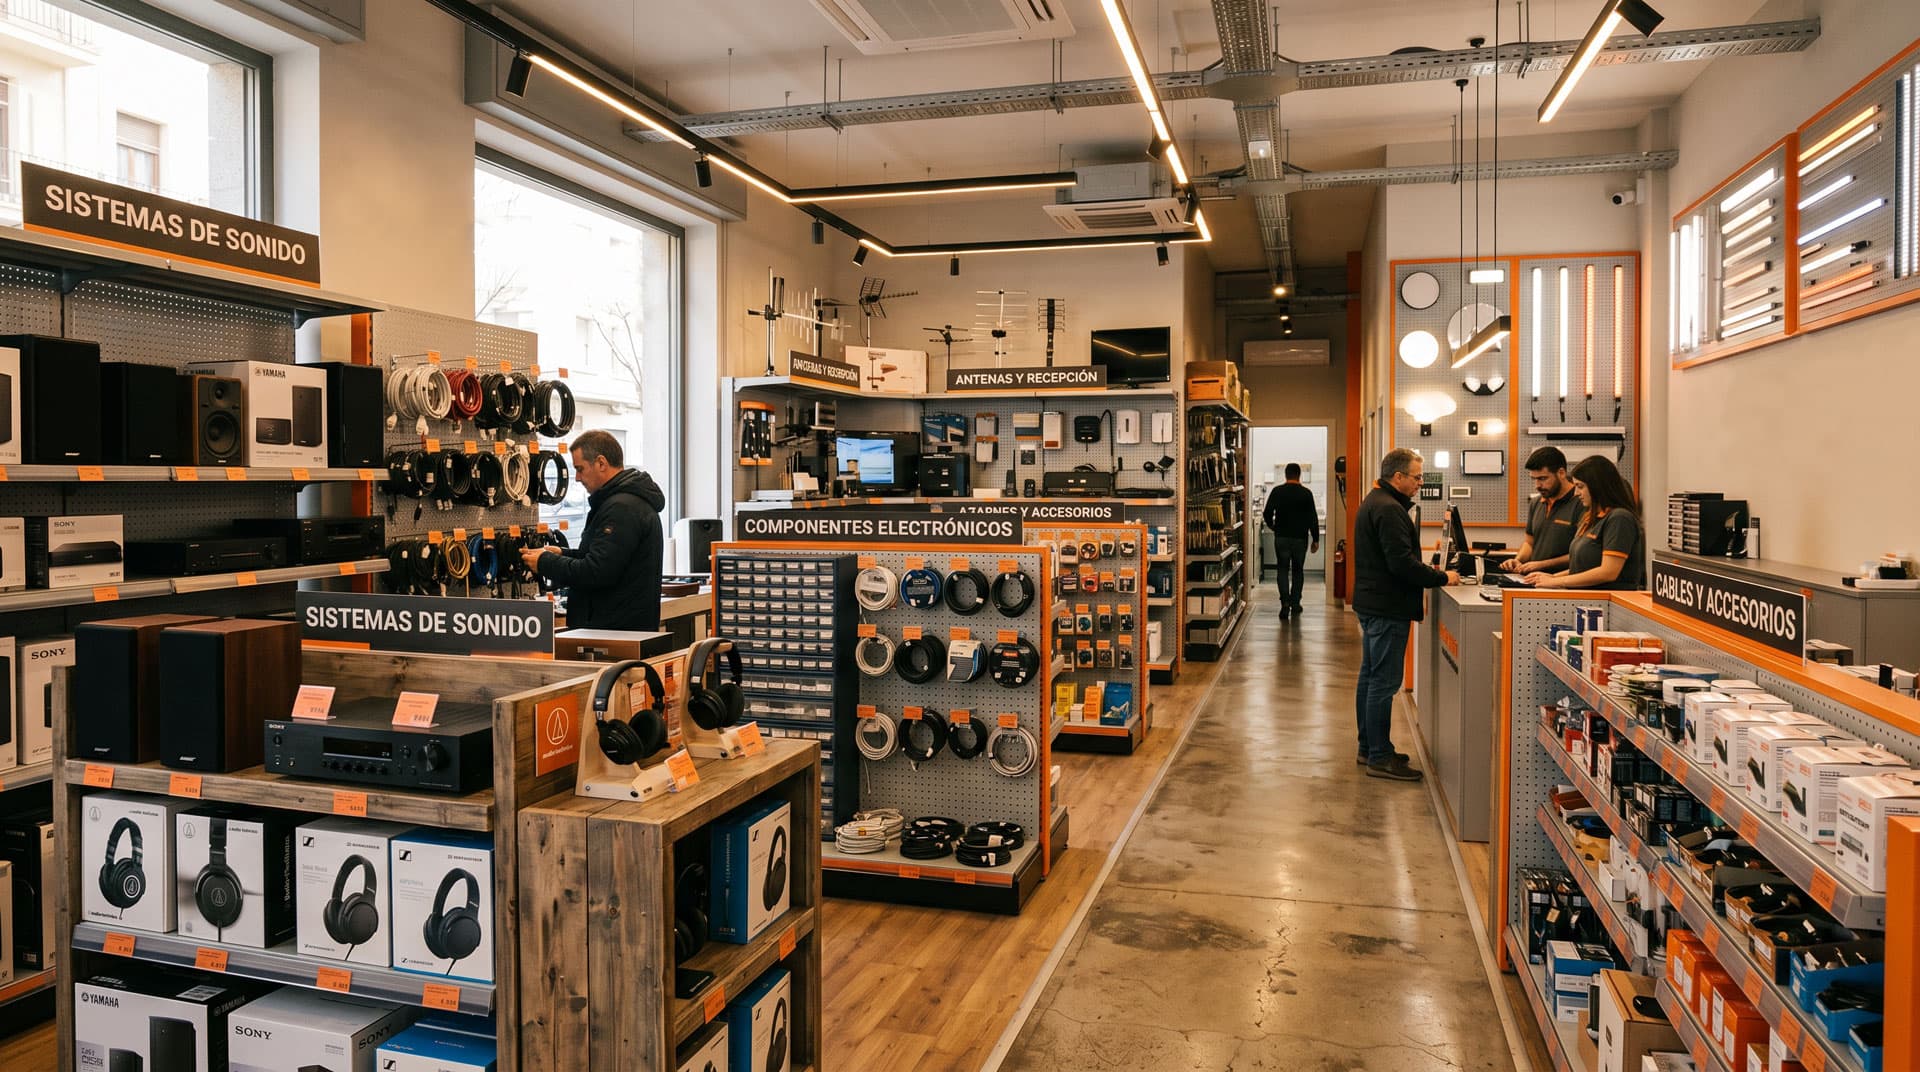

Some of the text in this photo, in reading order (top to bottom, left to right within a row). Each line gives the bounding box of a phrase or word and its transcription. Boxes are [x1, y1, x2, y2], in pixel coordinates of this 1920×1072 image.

[45, 184, 306, 265] SISTEMAS DE SONIDO
[262, 369, 286, 378] YAMAHA
[955, 367, 1098, 386] ANTENAS Y RECEPCIÓN
[1021, 507, 1029, 517] Y
[1031, 507, 1112, 519] ACCESORIOS
[54, 520, 76, 528] SONY
[744, 516, 1013, 538] COMPONENTES ELECTRÓNICOS
[1655, 572, 1796, 641] CABLES Y ACCESORIOS
[306, 606, 541, 638] SISTEMAS DE SONIDO
[31, 647, 67, 660] SONY
[90, 994, 119, 1009] YAMAHA
[235, 1025, 272, 1040] SONY
[359, 1023, 393, 1051] SONY
